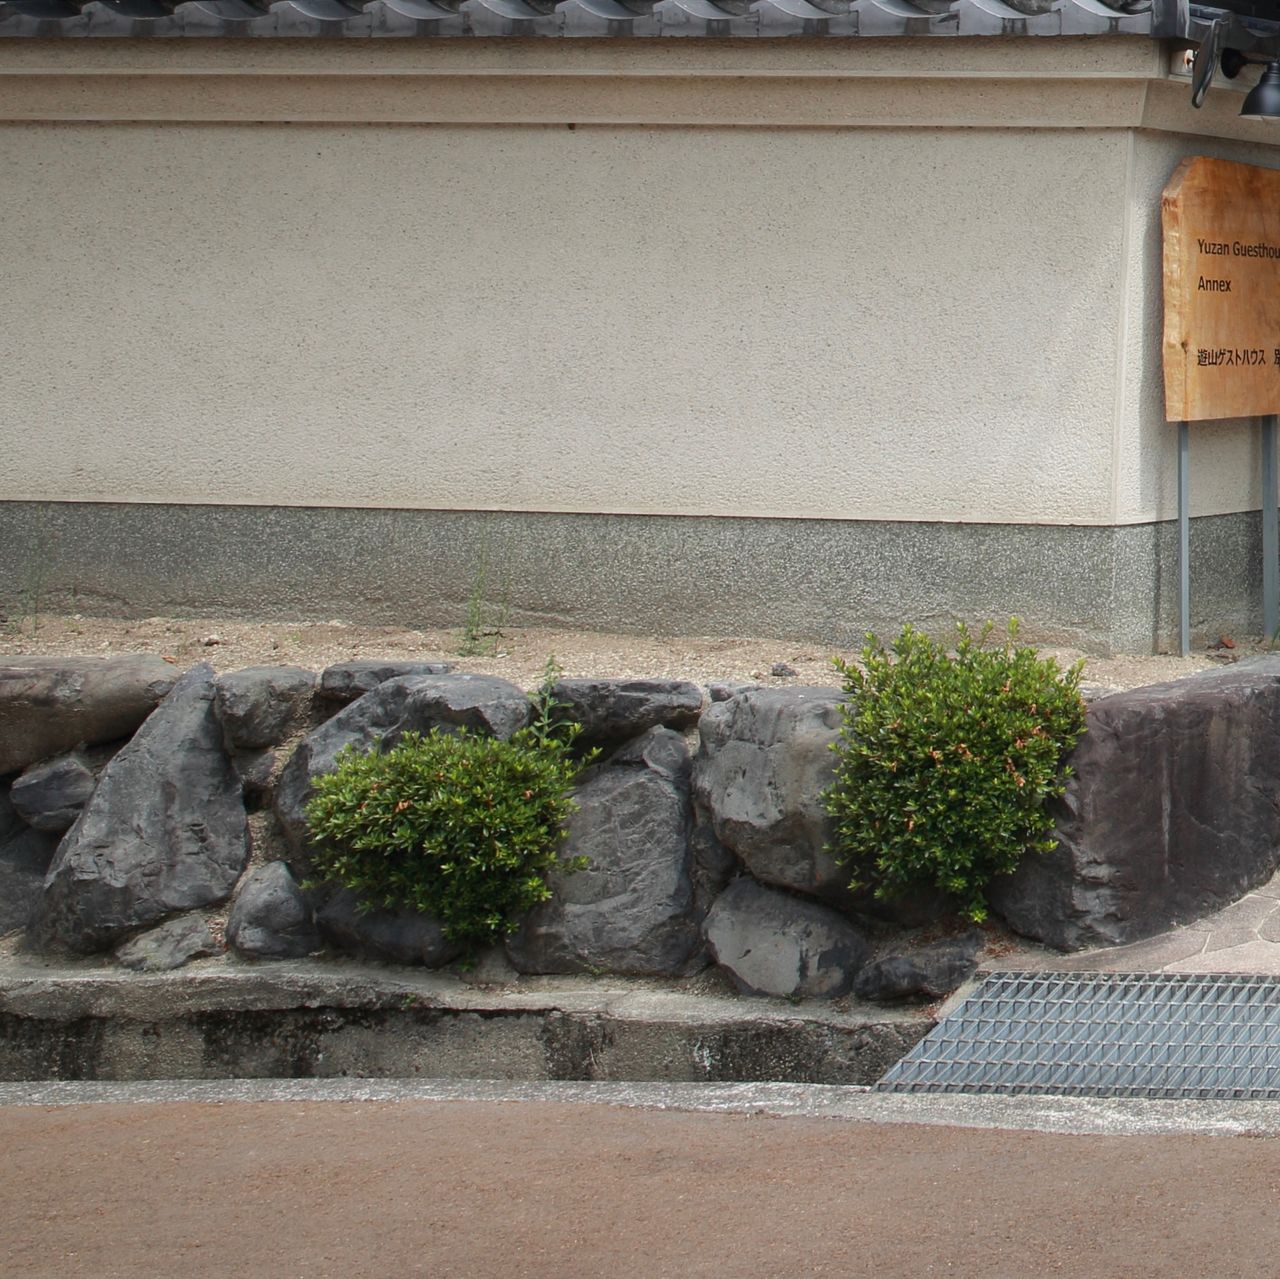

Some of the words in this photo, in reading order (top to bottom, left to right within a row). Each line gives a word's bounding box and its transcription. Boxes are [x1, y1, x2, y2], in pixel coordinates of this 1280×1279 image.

[1198, 239, 1230, 255] Yuzan
[1198, 276, 1231, 292] Annex
[1198, 349, 1266, 366] 遊山ゲストハウス
